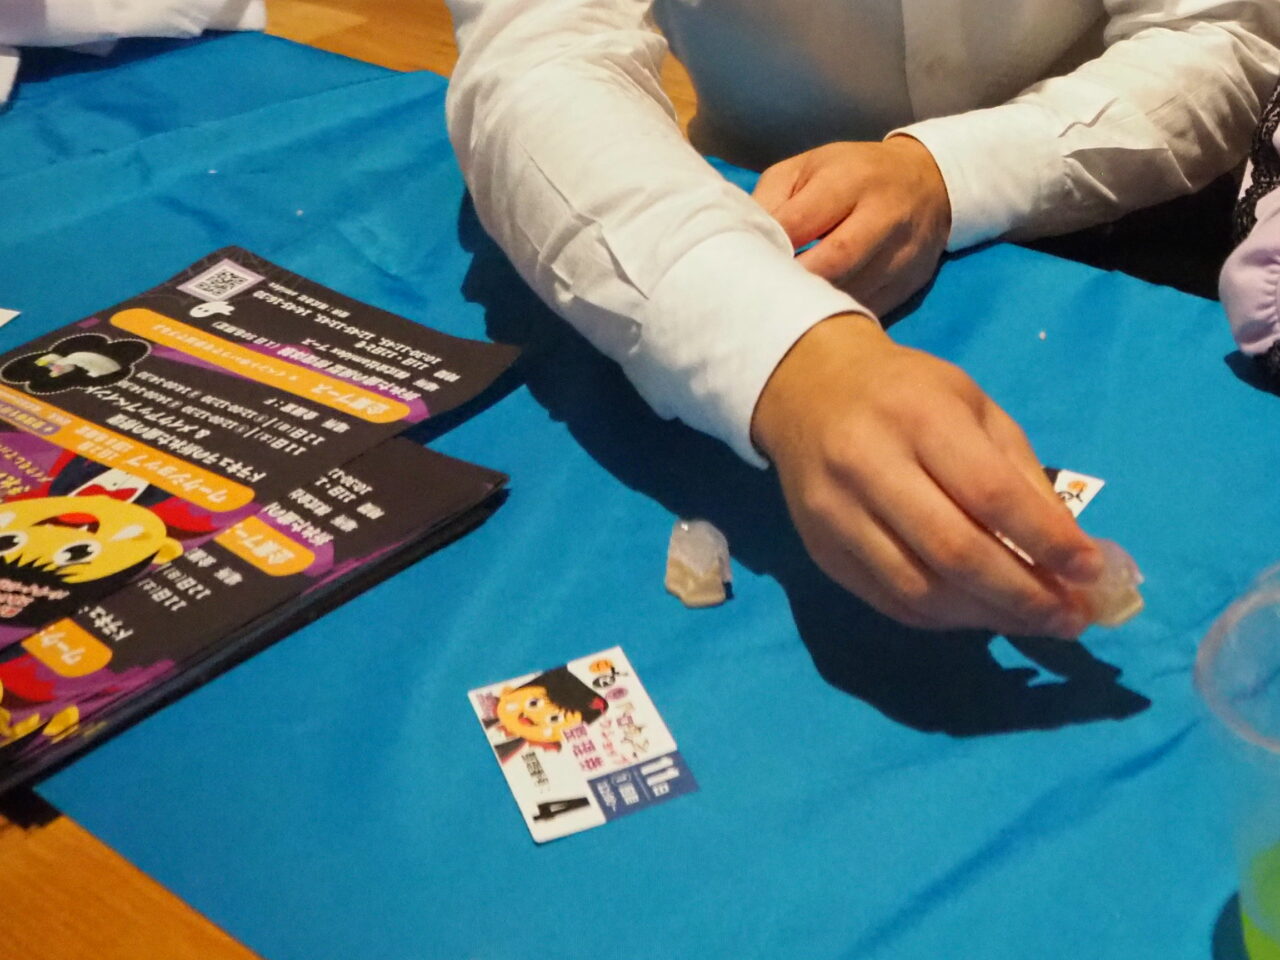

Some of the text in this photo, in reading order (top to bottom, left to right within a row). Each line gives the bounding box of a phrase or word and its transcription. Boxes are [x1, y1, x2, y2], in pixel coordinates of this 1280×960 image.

[83, 385, 195, 433] メイクアップペイント
[125, 454, 228, 502] ワークショップ
[533, 797, 590, 823] 4
